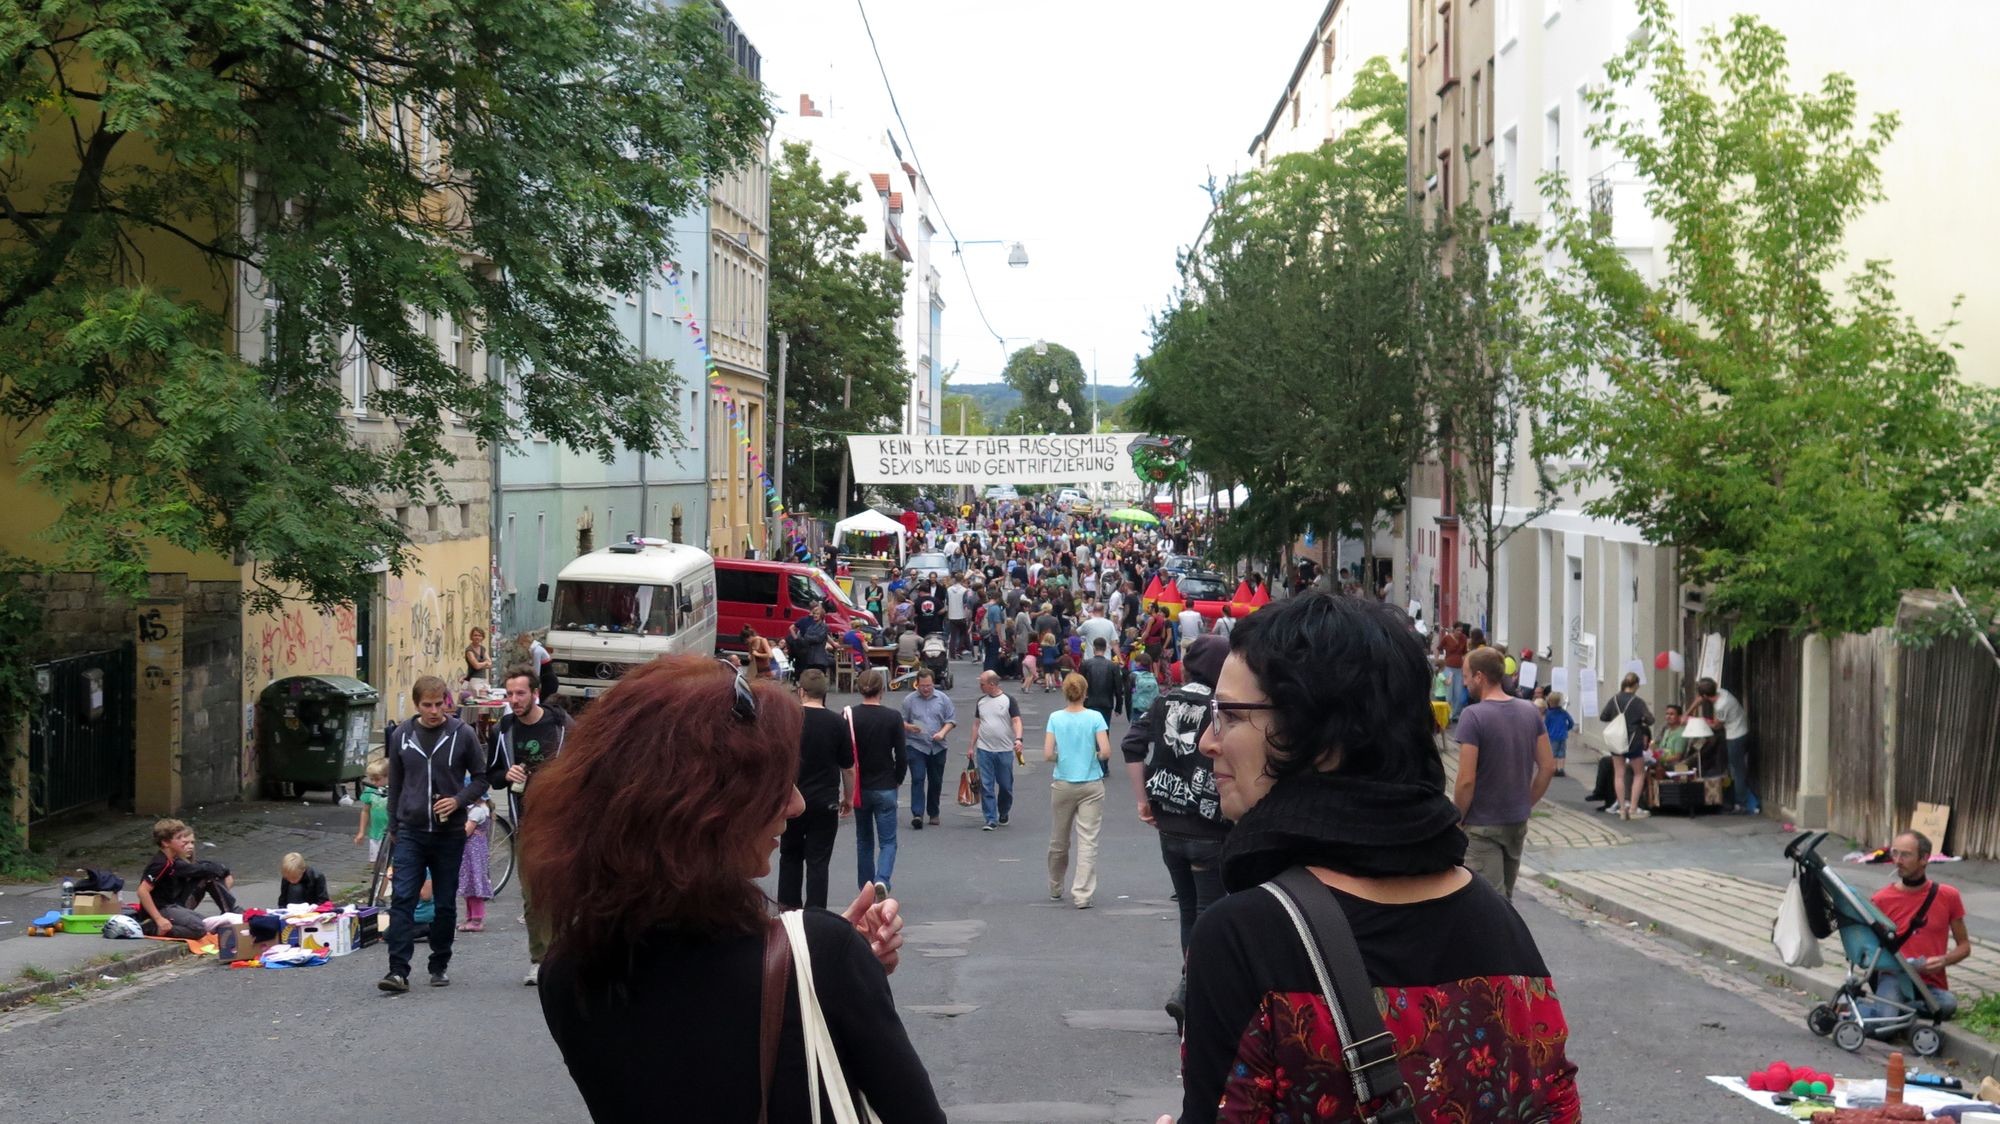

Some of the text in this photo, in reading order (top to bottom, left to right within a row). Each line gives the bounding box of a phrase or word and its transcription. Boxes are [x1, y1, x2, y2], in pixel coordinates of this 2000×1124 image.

[879, 437, 1118, 458] KEIN KIEZ FÜR RASSISMUS,
[879, 457, 1114, 475] SEXISMUS UND GENTRIFIZIERUNG
